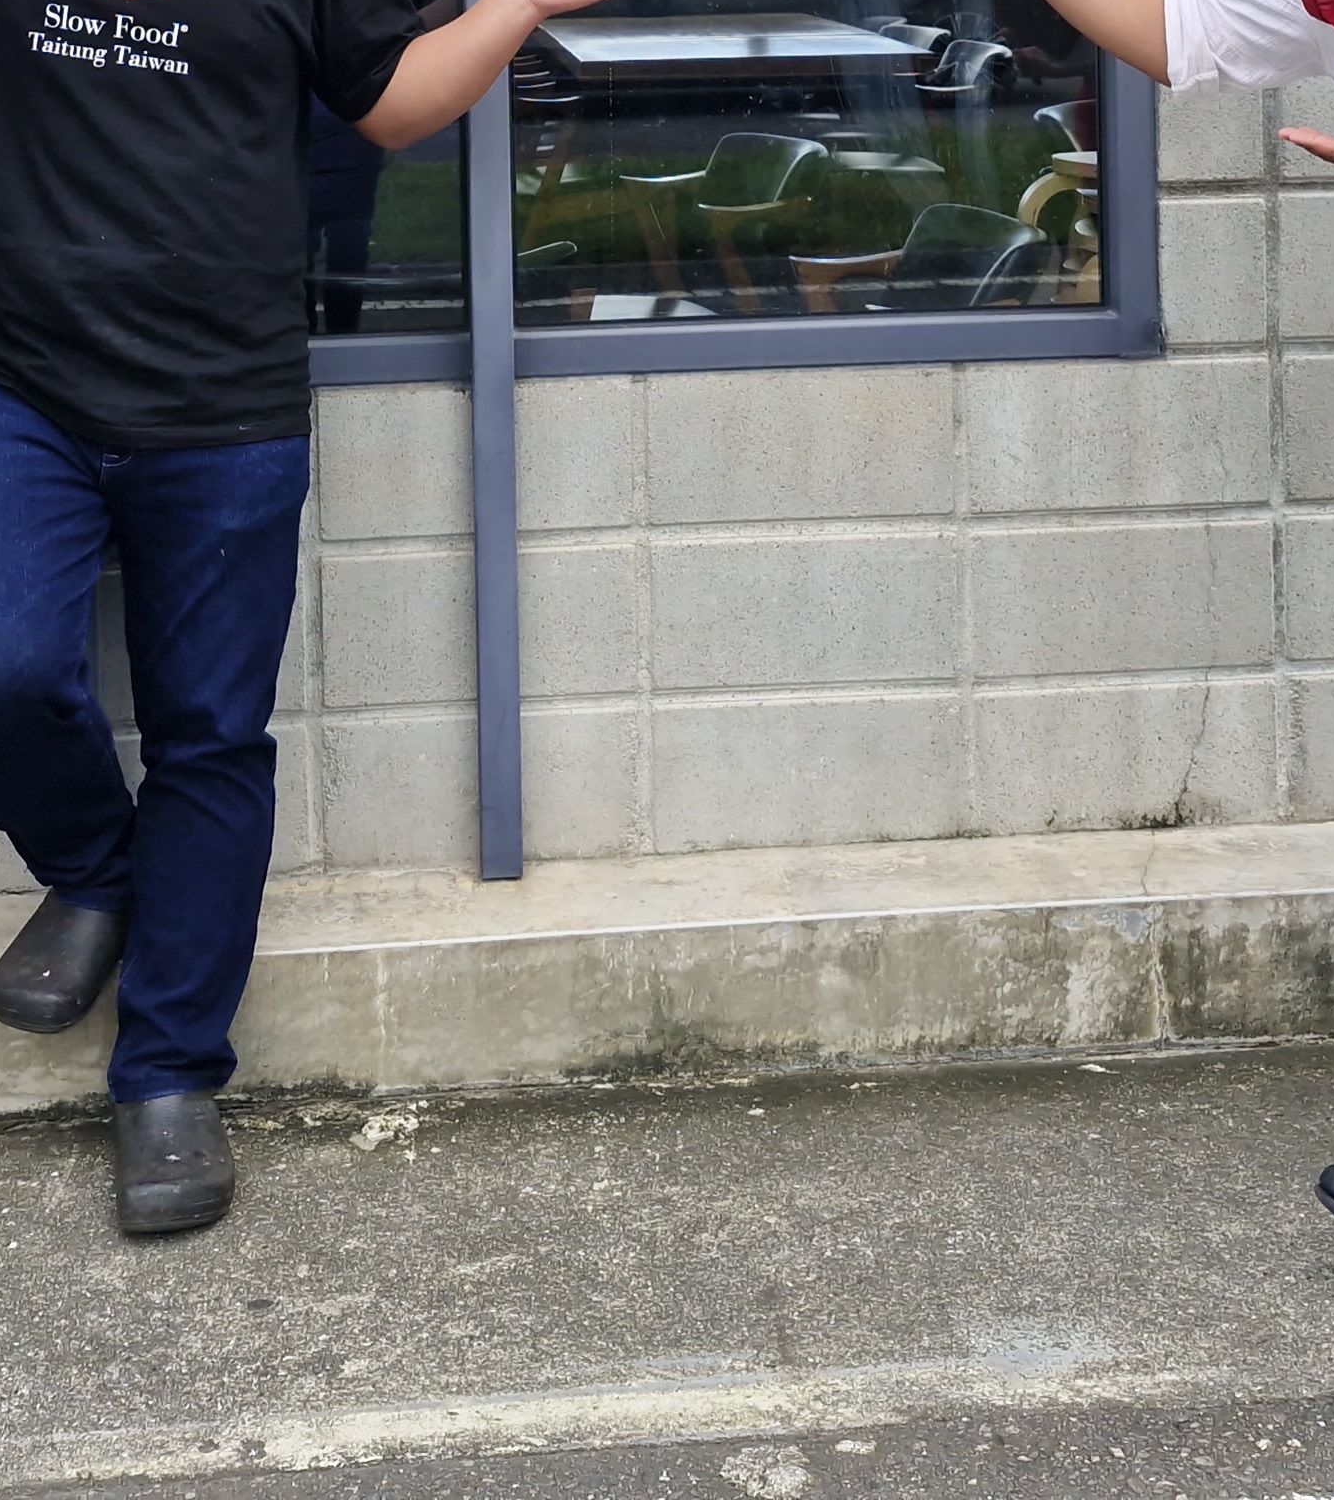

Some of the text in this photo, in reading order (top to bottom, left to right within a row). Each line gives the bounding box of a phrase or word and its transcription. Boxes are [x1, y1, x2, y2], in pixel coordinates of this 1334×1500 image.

[44, 3, 107, 36] Slow
[28, 31, 189, 75] Taitung Taiwan
